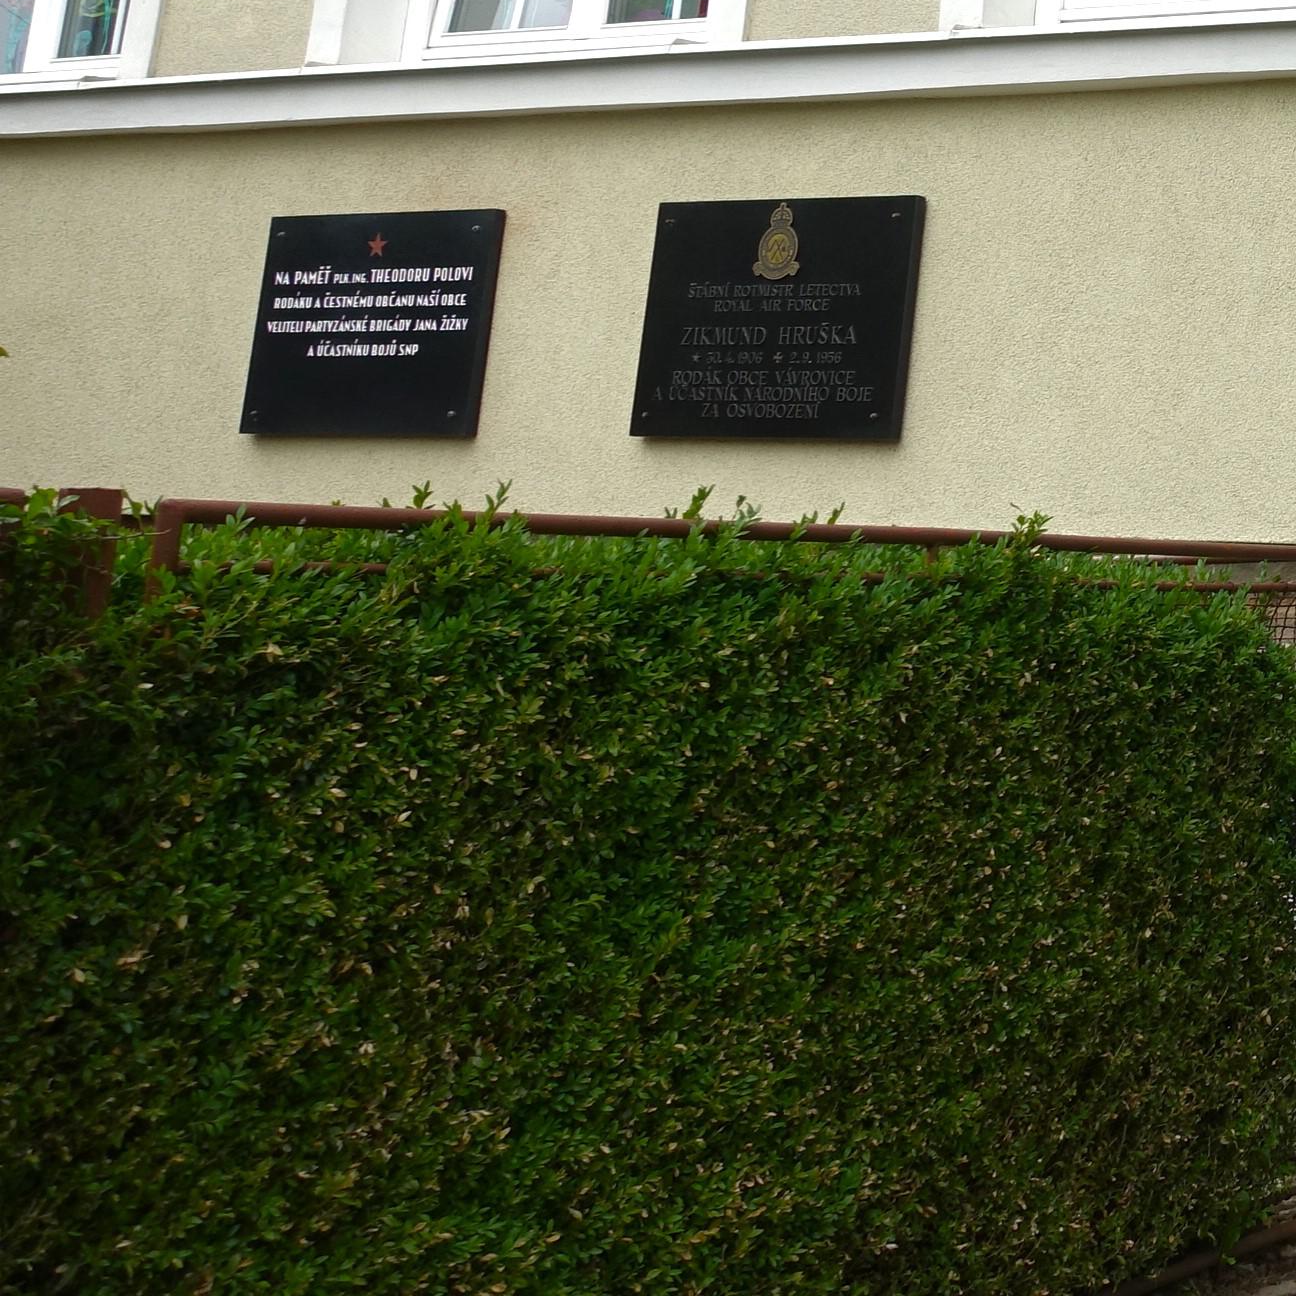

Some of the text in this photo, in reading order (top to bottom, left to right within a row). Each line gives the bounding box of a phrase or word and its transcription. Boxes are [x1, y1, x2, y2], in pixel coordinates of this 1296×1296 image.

[274, 271, 289, 285] NA
[294, 265, 332, 285] PAMĚŤ
[370, 267, 431, 283] THEODORU
[433, 266, 474, 282] POLOVI
[273, 288, 467, 309] RODÁKU A ČESTNÉMU OBČANU NAŠÍ OBCE
[687, 281, 863, 298] ŠTÁBNÍ ROTMISTR LETECTVA
[713, 298, 832, 312] ROYAL AIR FORCE
[267, 314, 469, 333] VELITELI PARTYZÁNSKÉ BRIGÁDY JANA ŽIŽKY
[680, 322, 857, 345] ZIKMUND HRUŠKA
[307, 338, 419, 357] A ÚČASTNÍKU BOJŮ SNP
[672, 366, 856, 385] RODÁK OBCE VÁVROVICE
[652, 386, 662, 400] A
[743, 384, 830, 401] NÁRODNÍHO
[836, 386, 874, 402] BOJE
[700, 401, 821, 418] ZA OSVOBOZENÍ
